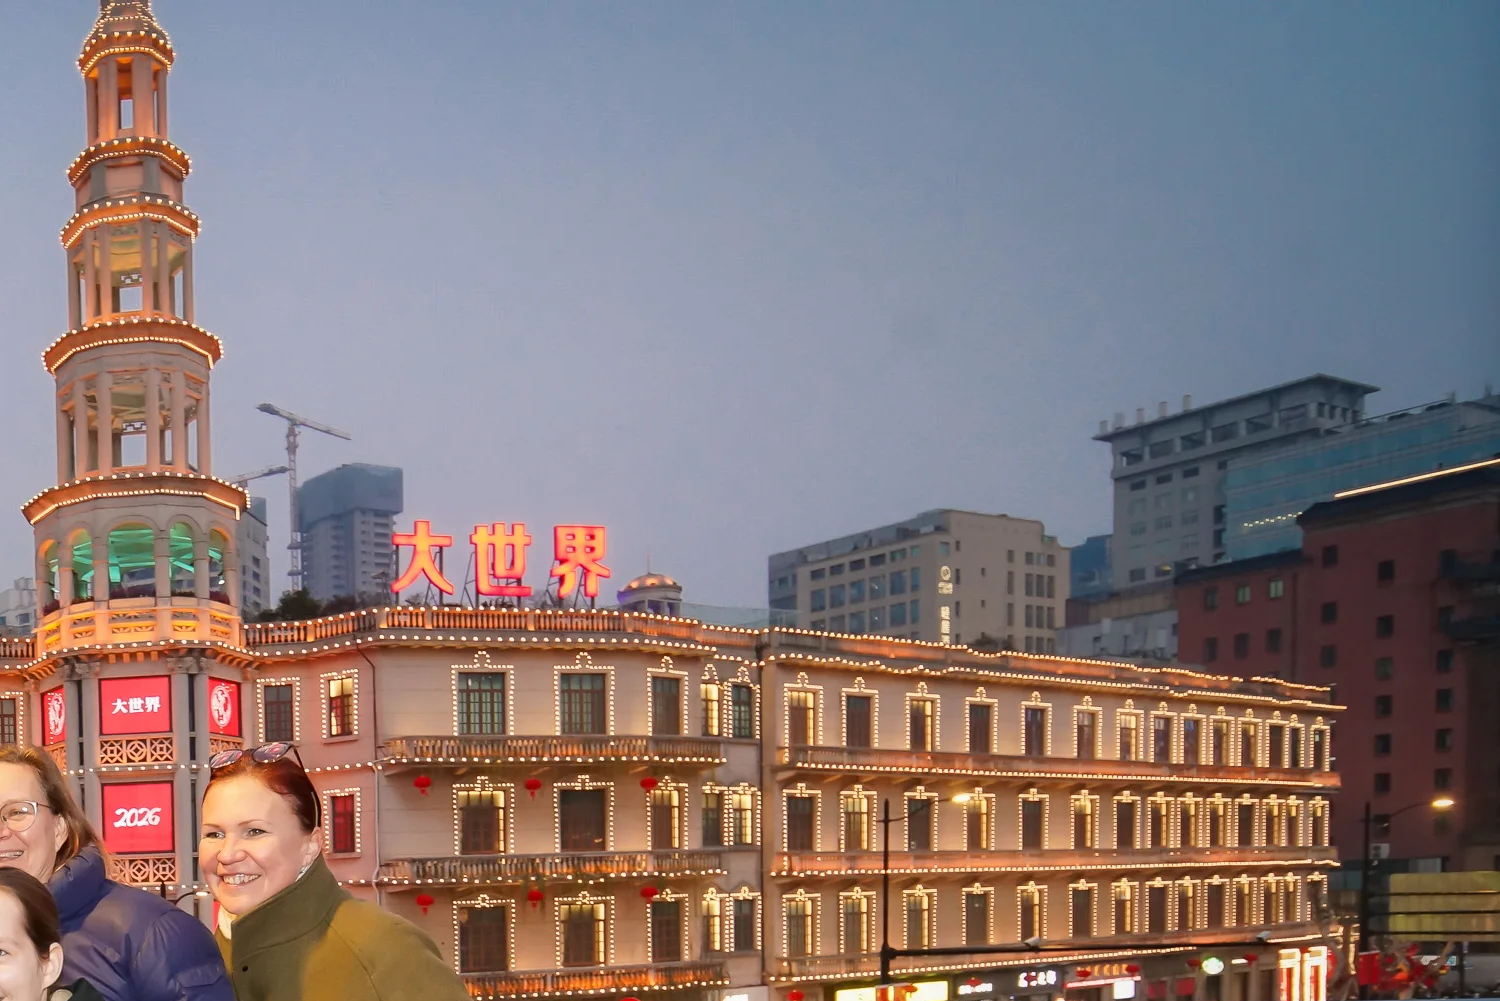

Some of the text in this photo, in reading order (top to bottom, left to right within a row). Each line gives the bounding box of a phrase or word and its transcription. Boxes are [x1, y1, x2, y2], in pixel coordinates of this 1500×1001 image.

[390, 519, 611, 599] 大世界
[111, 696, 161, 715] 大世界
[113, 807, 162, 828] 2026
